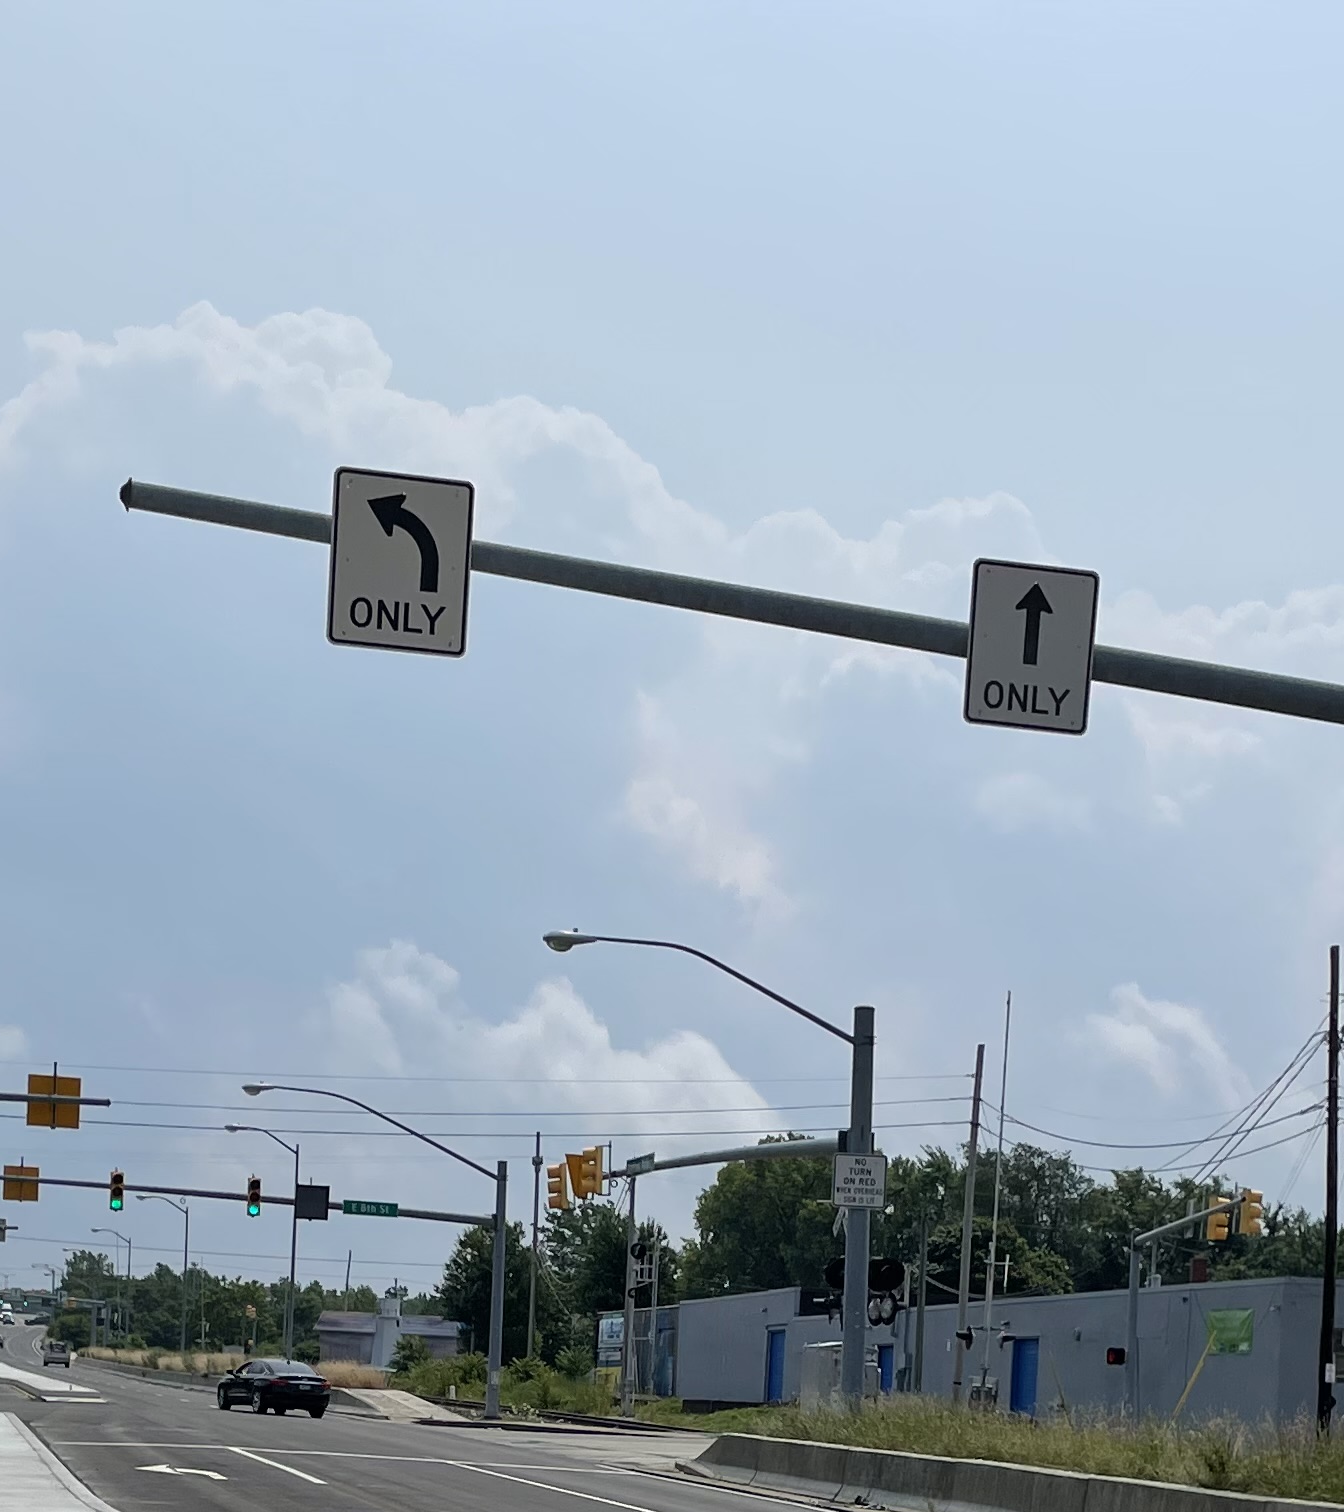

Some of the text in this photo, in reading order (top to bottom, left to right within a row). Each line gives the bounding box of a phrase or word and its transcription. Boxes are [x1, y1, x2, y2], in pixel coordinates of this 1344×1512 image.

[349, 597, 447, 636] ONLY
[983, 680, 1071, 717] ONLY
[854, 1157, 867, 1167] NO
[848, 1167, 872, 1177] TURN
[843, 1177, 877, 1187] ON RED
[351, 1202, 358, 1213] E
[379, 1204, 390, 1215] St
